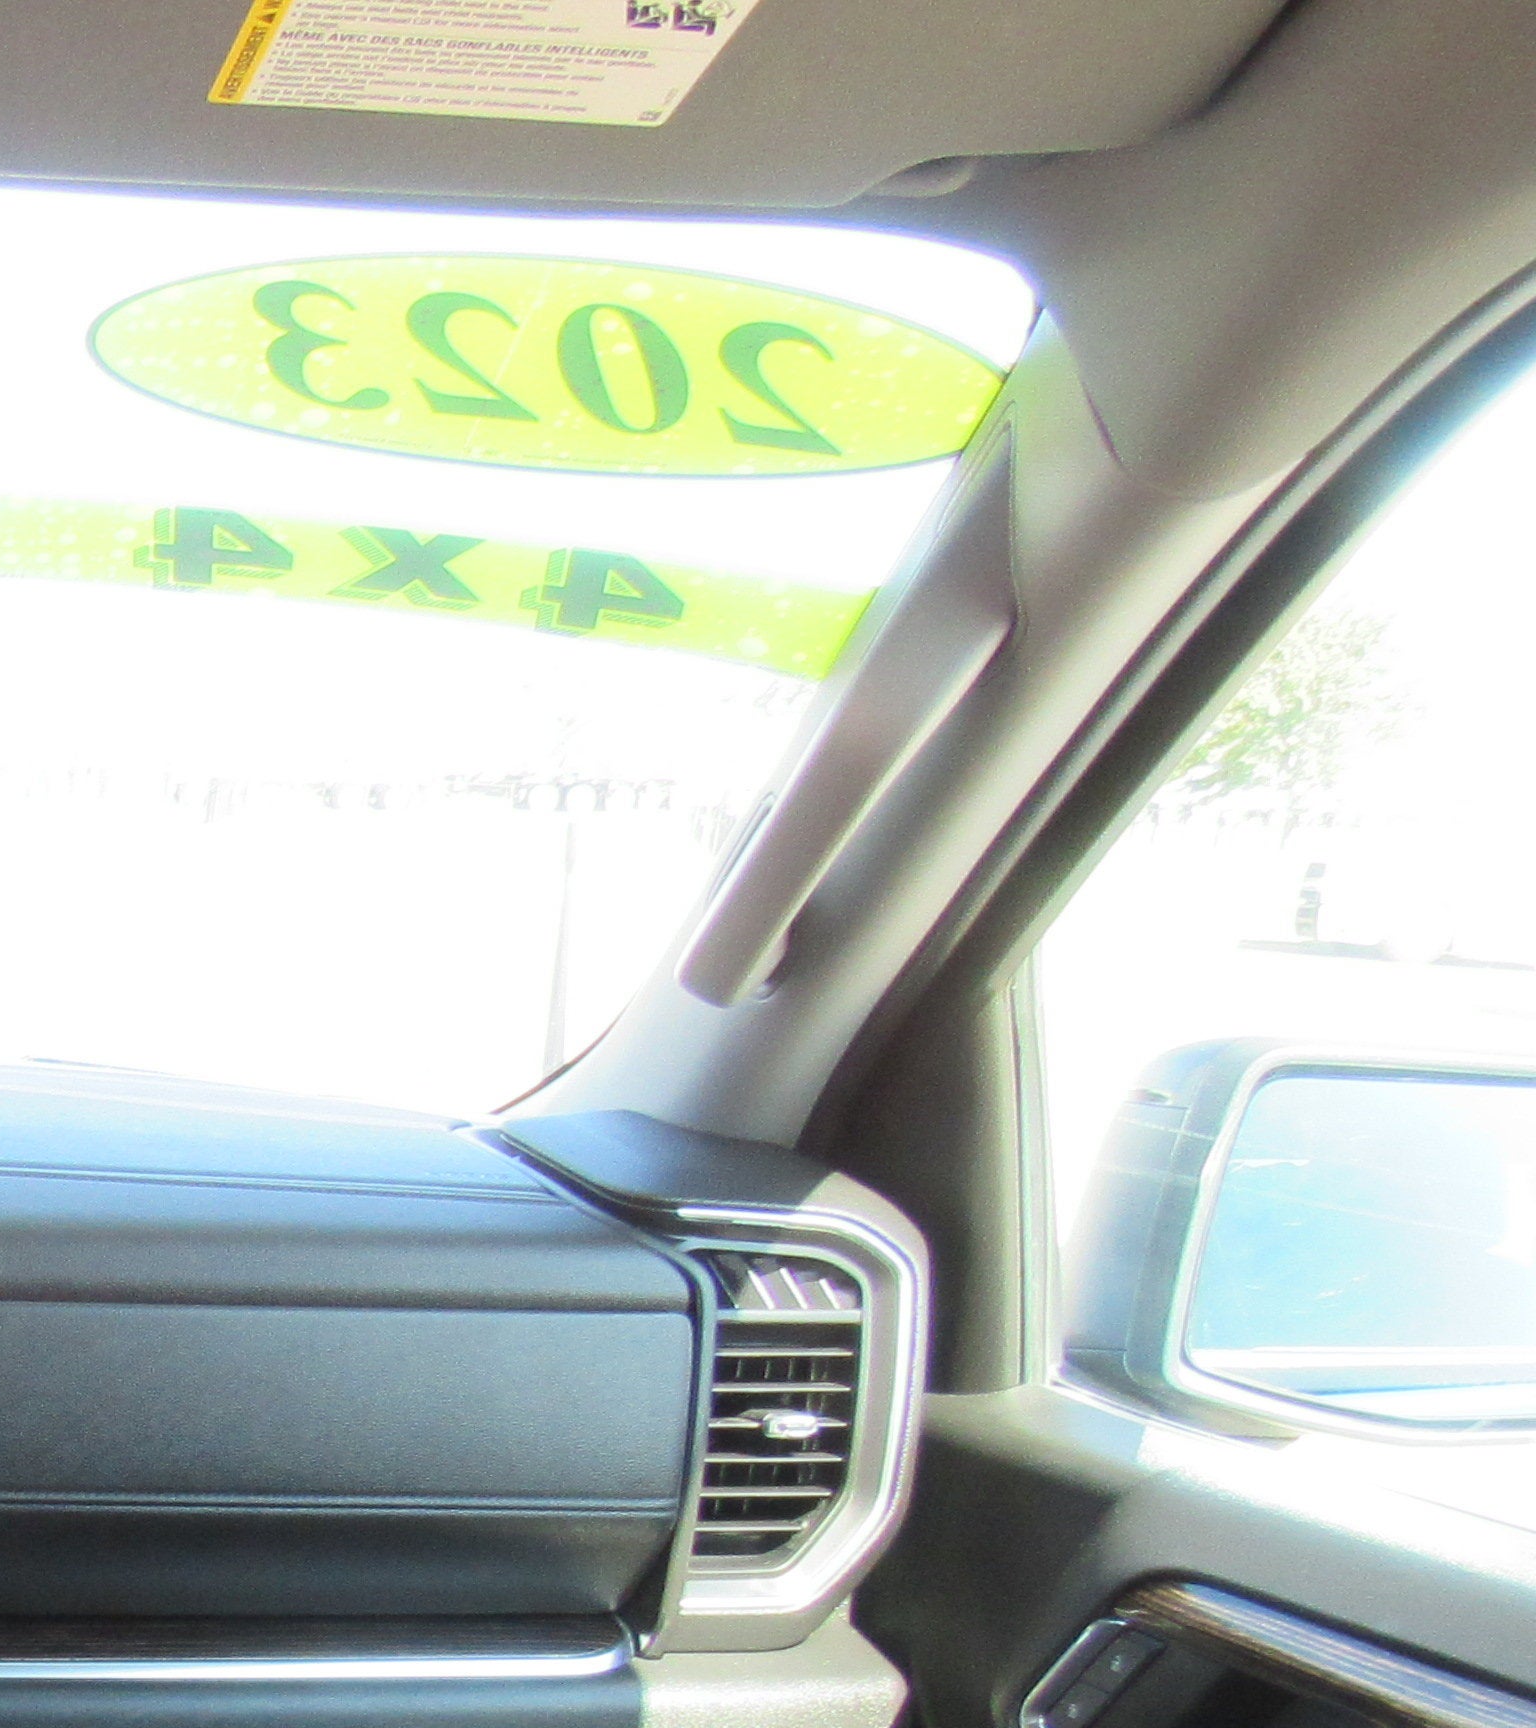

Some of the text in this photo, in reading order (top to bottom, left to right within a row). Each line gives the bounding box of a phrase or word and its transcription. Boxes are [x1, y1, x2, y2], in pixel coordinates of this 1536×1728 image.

[328, 33, 368, 44] AVEC
[370, 35, 400, 46] DES
[547, 45, 649, 59] INTELLIGENTS
